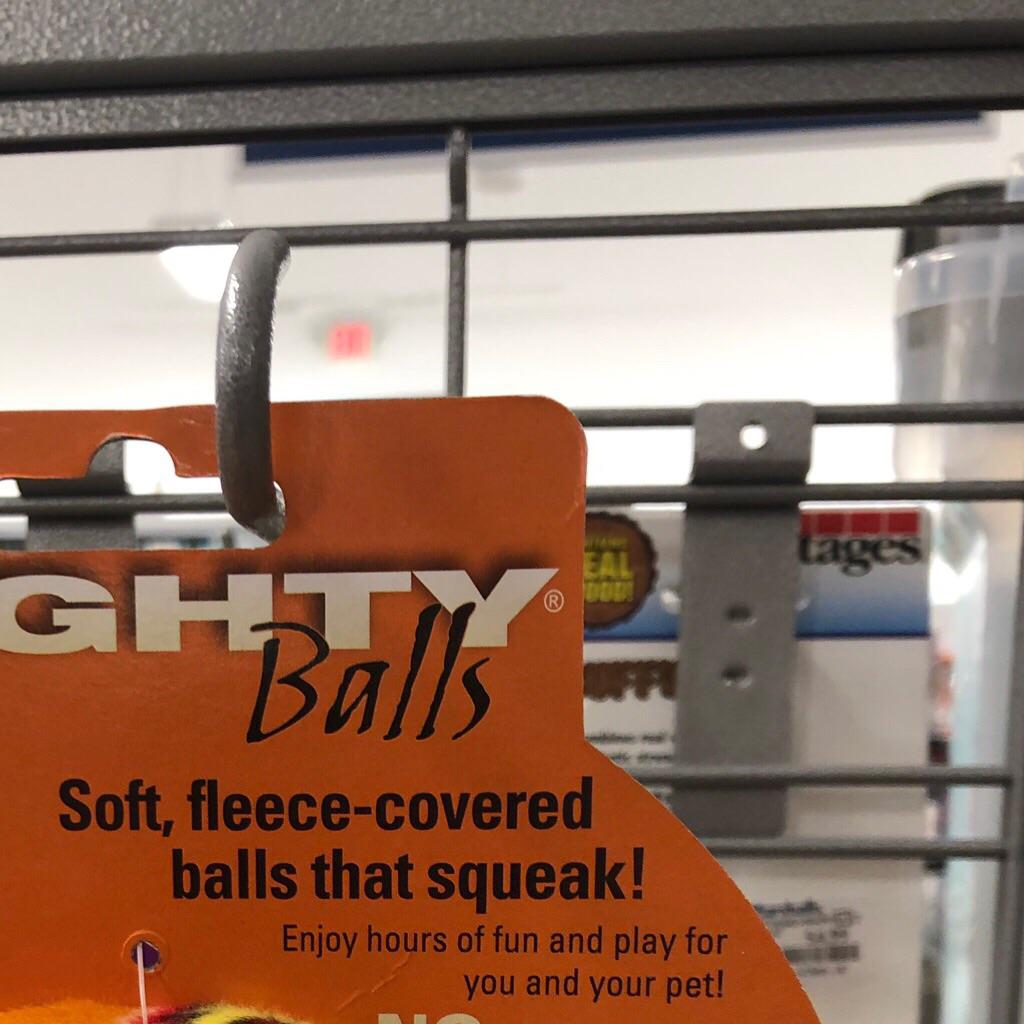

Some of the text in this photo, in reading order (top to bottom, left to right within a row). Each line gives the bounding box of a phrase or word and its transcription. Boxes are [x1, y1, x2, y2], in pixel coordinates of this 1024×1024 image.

[246, 602, 491, 743] Balls
[58, 775, 593, 837] Soft, fleece-covered
[172, 847, 644, 914] balls that squeak!
[282, 924, 728, 961] Enjoy hours of fun and play for
[464, 968, 724, 1004] you and your pet!
